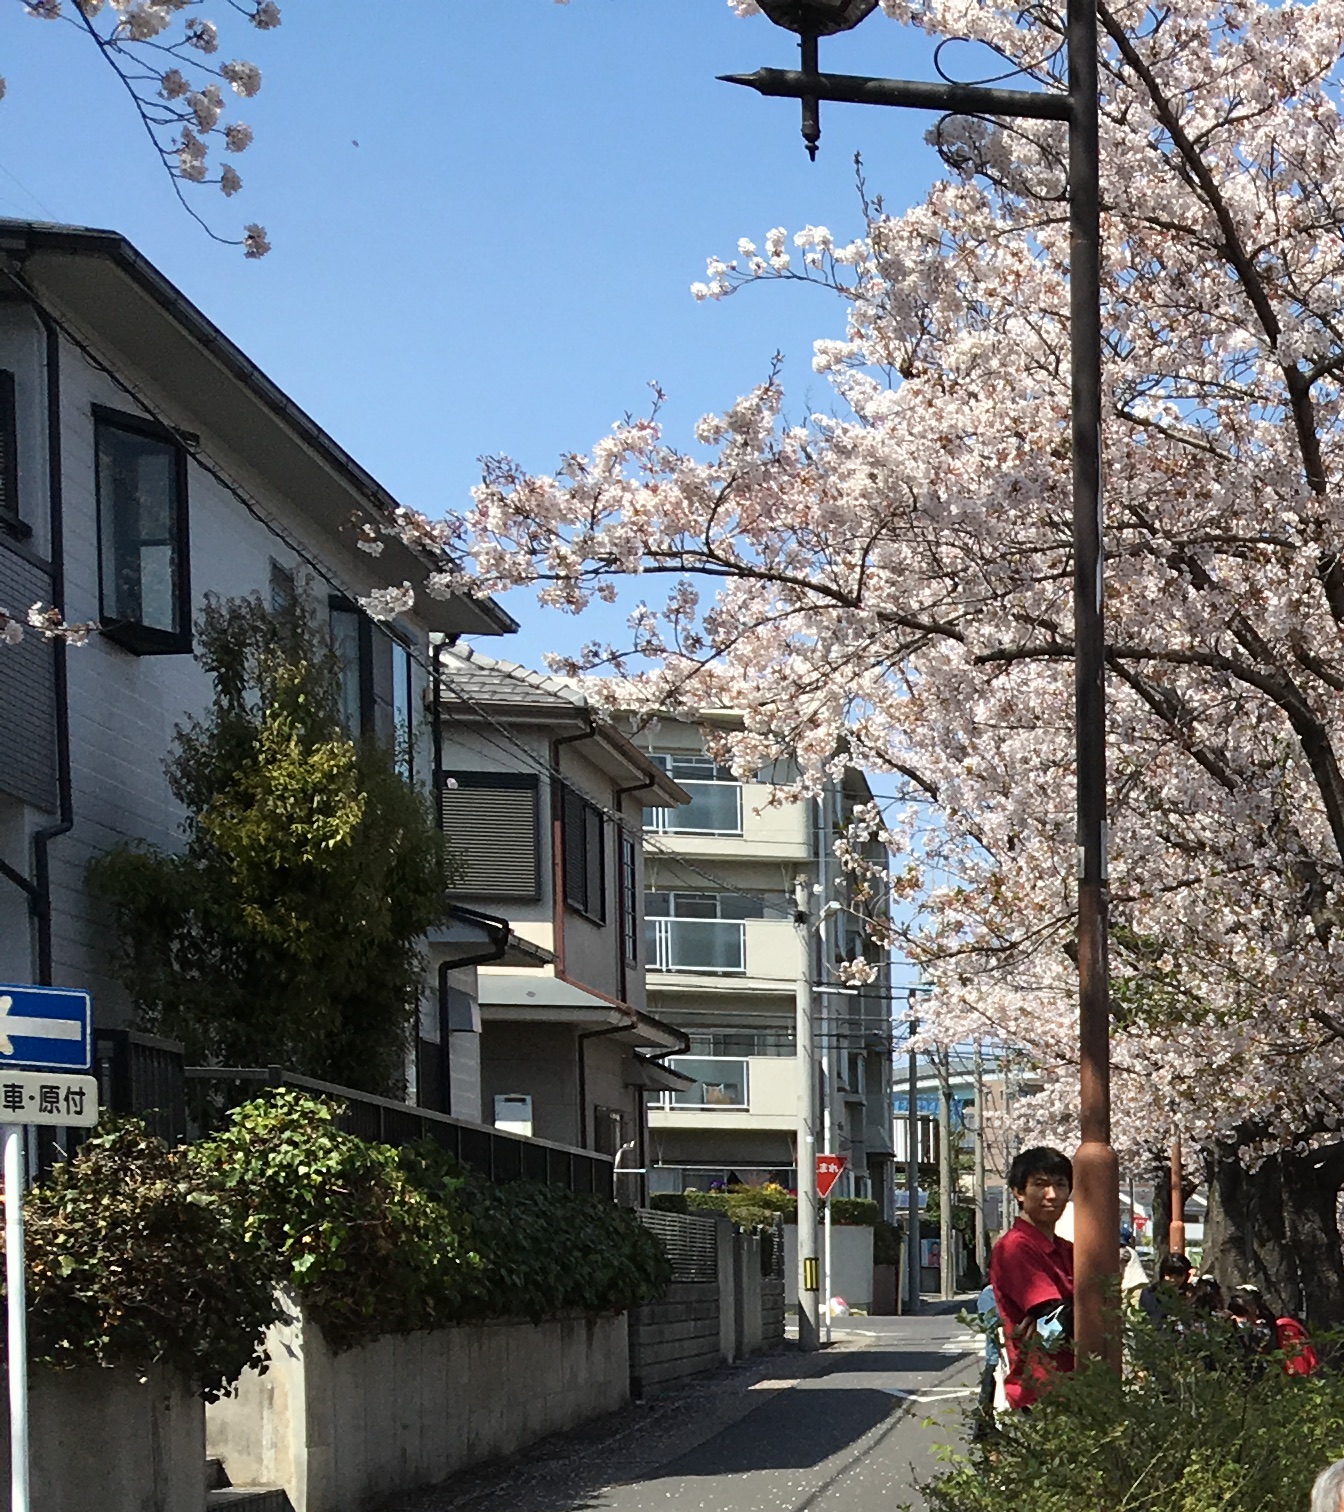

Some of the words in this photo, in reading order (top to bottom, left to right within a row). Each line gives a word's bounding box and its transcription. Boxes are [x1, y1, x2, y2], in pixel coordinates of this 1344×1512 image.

[2, 1082, 86, 1116] 車・原付
[816, 1162, 839, 1173] まれ
